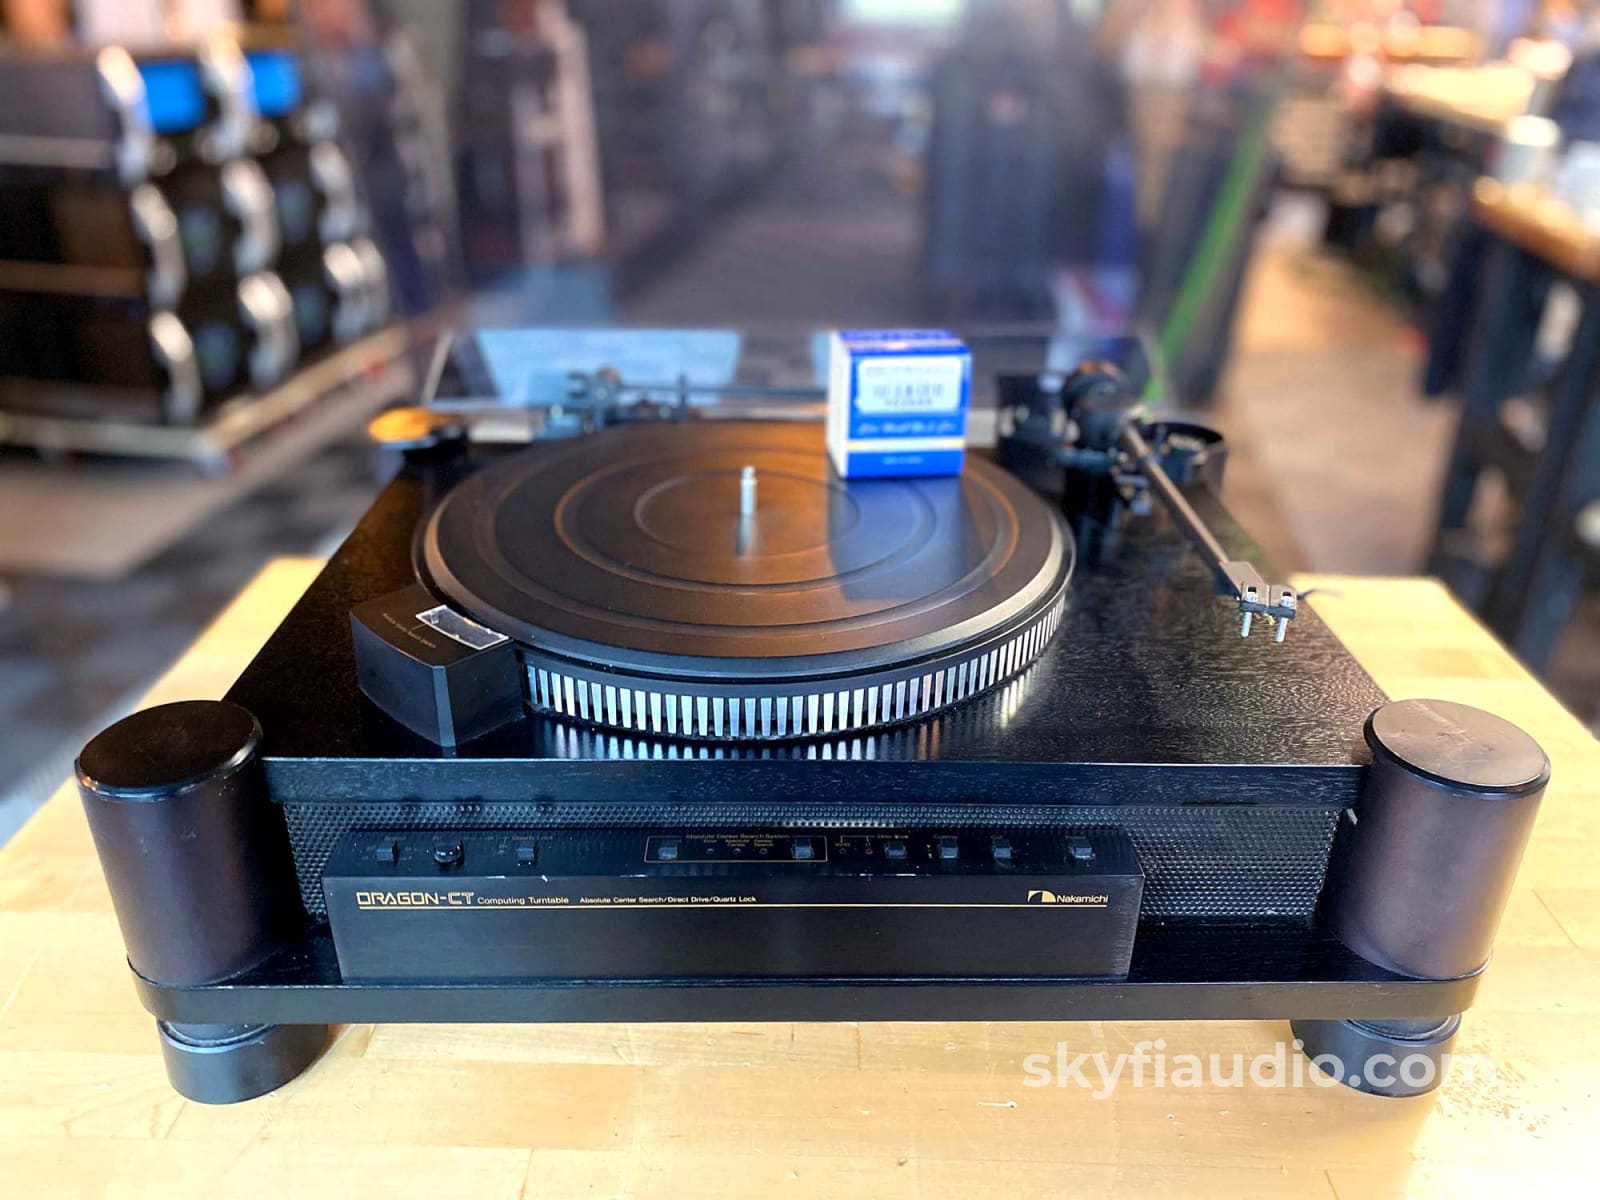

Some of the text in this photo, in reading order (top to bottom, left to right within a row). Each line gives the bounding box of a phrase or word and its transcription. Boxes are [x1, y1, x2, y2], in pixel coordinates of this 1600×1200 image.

[356, 891, 475, 905] DRAGON-CT
[477, 896, 570, 906] Computing Turntable
[580, 896, 611, 904] Absolute
[613, 896, 638, 904] Center
[1056, 894, 1109, 903] Nakamichi
